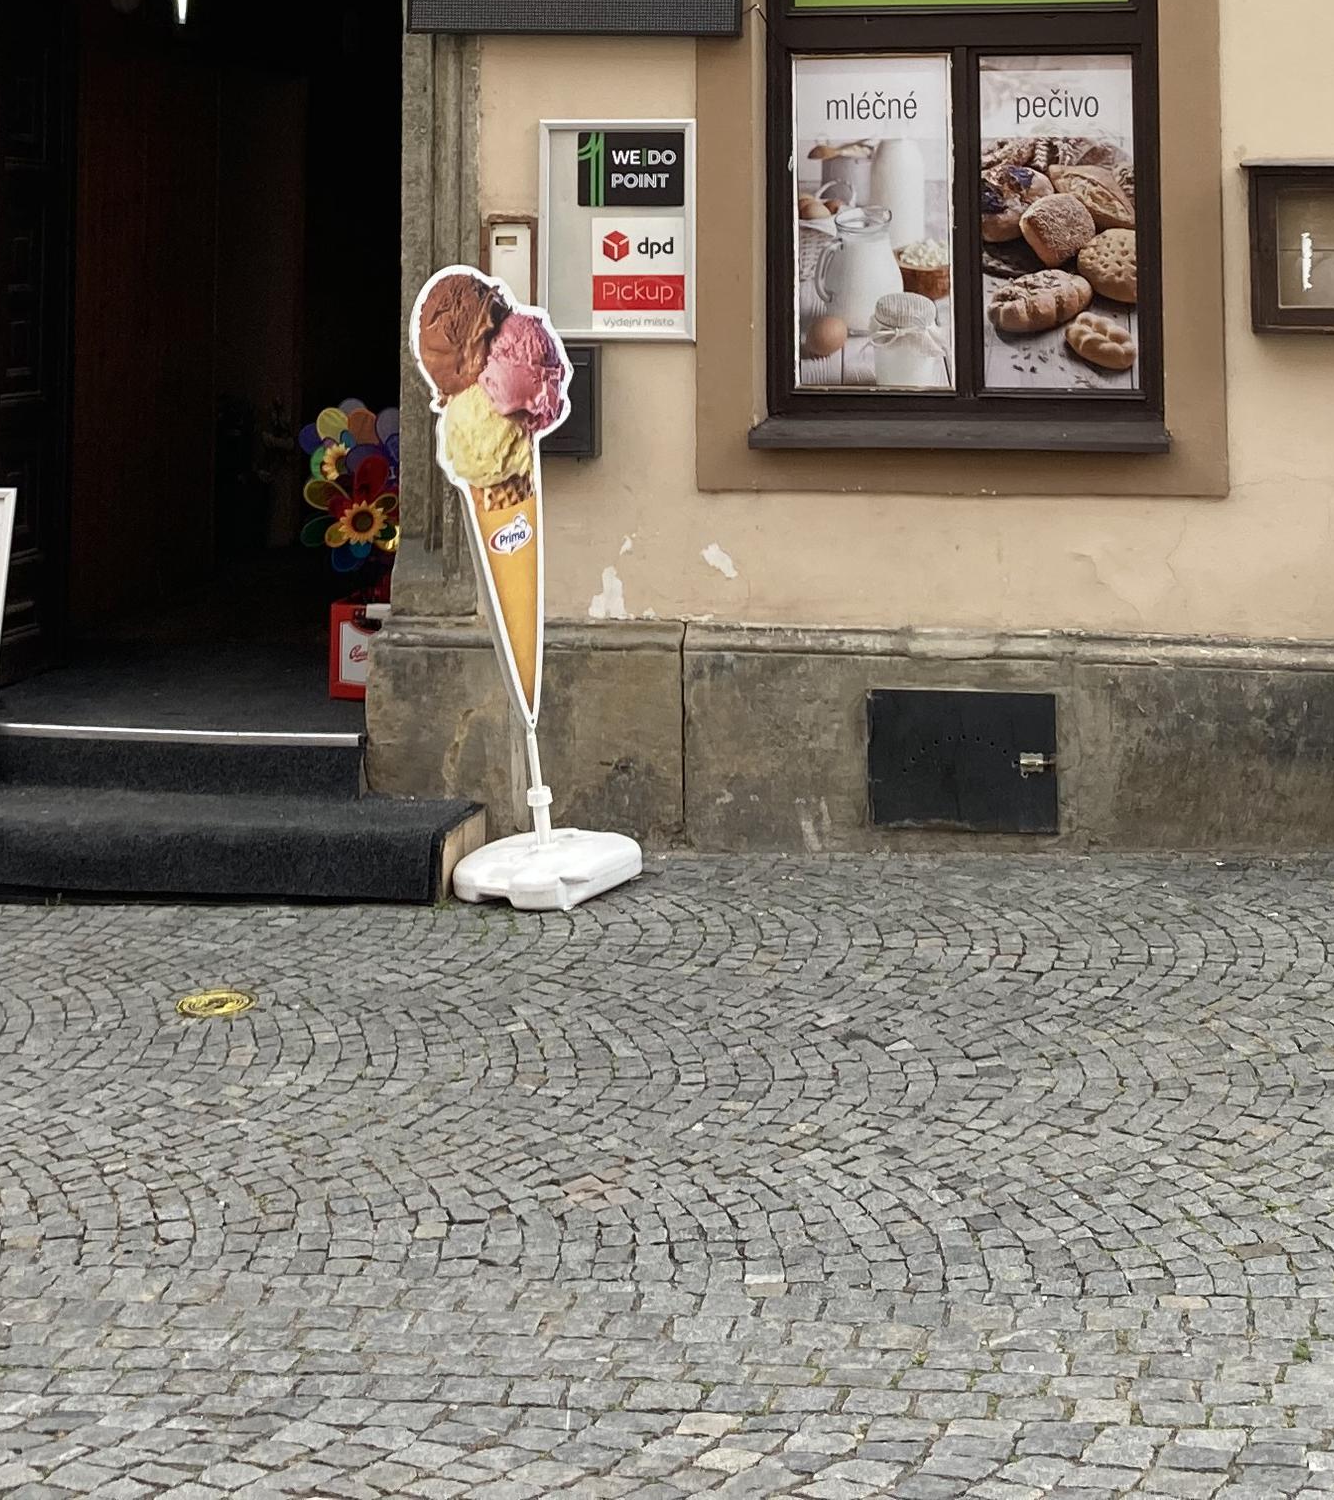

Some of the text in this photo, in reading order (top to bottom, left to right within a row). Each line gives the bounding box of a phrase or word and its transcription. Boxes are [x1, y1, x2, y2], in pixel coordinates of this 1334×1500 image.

[825, 90, 918, 121] mléčné
[1015, 88, 1100, 124] pečivo
[610, 172, 670, 189] POINT
[636, 236, 674, 260] dpd
[602, 281, 674, 304] Pickup
[499, 530, 526, 547] Prima
